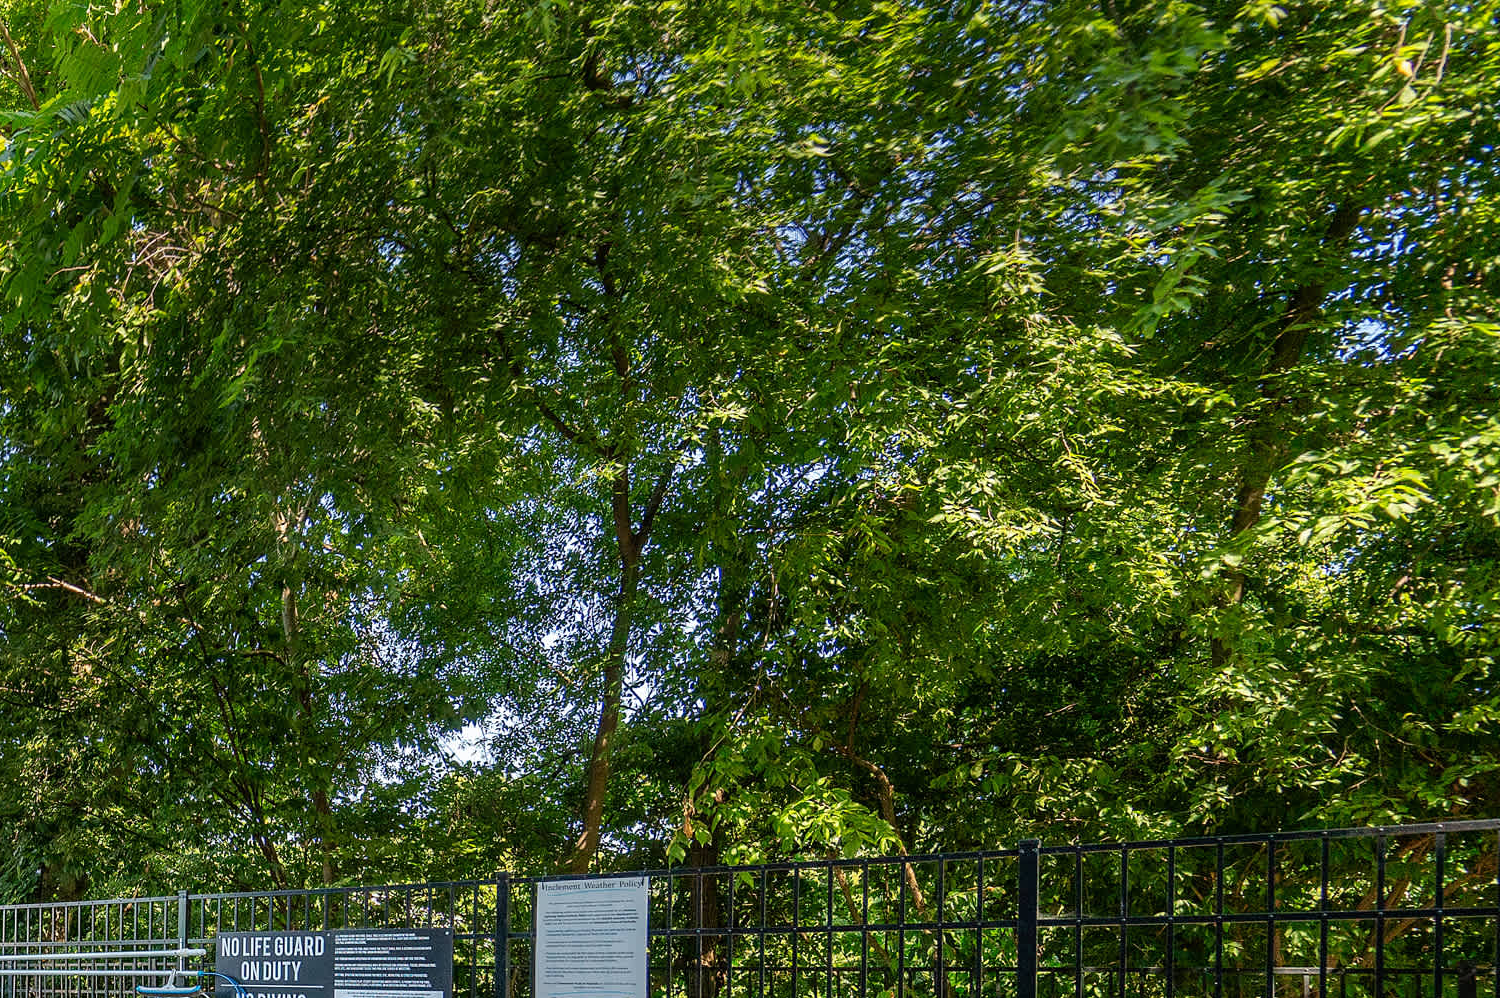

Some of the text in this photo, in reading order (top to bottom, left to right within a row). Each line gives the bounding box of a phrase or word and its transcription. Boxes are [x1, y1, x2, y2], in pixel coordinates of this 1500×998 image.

[545, 880, 642, 891] Inclement Weather Policy
[221, 937, 240, 957] NO
[243, 937, 271, 956] LIFE
[274, 936, 324, 956] GUARD
[241, 961, 301, 981] ON DUTY
